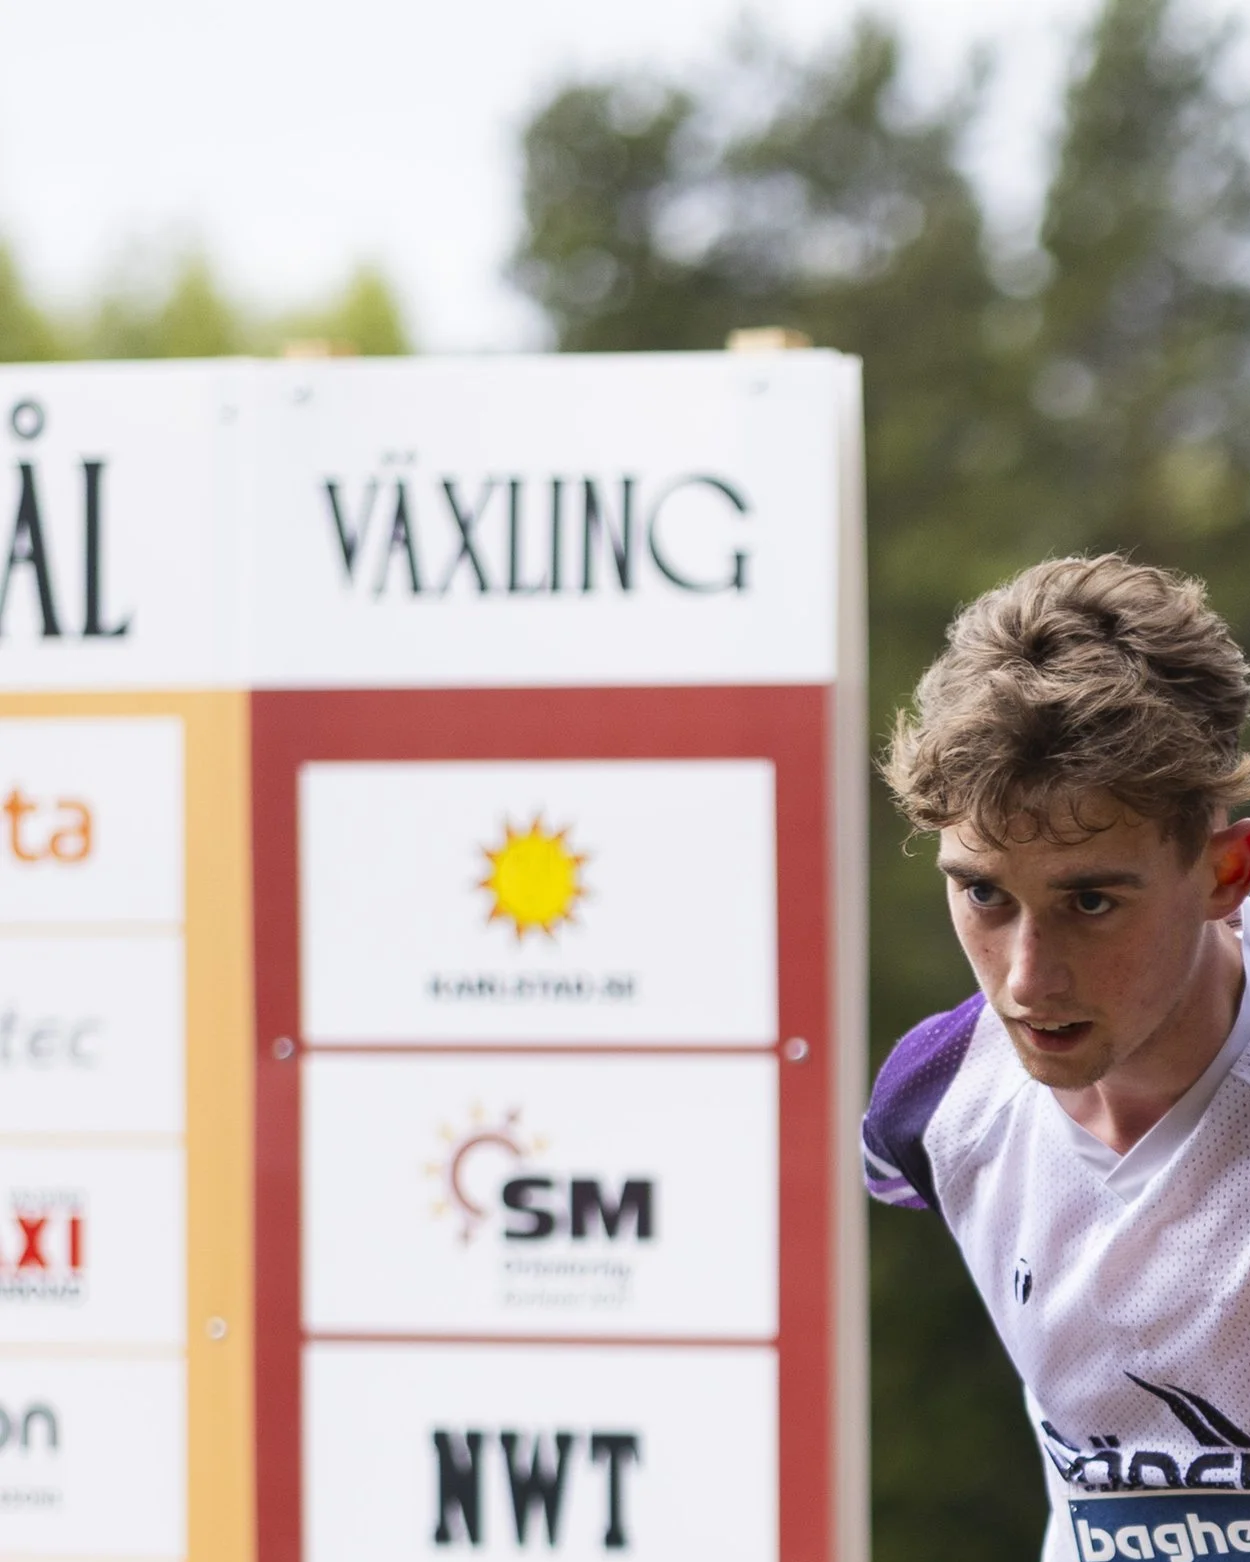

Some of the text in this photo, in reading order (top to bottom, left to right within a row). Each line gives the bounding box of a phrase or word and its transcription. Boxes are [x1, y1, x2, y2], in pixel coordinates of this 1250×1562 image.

[322, 452, 754, 596] VÄXLING
[0, 1215, 83, 1269] XI
[501, 1176, 657, 1242] SM
[430, 1429, 642, 1549] NWT
